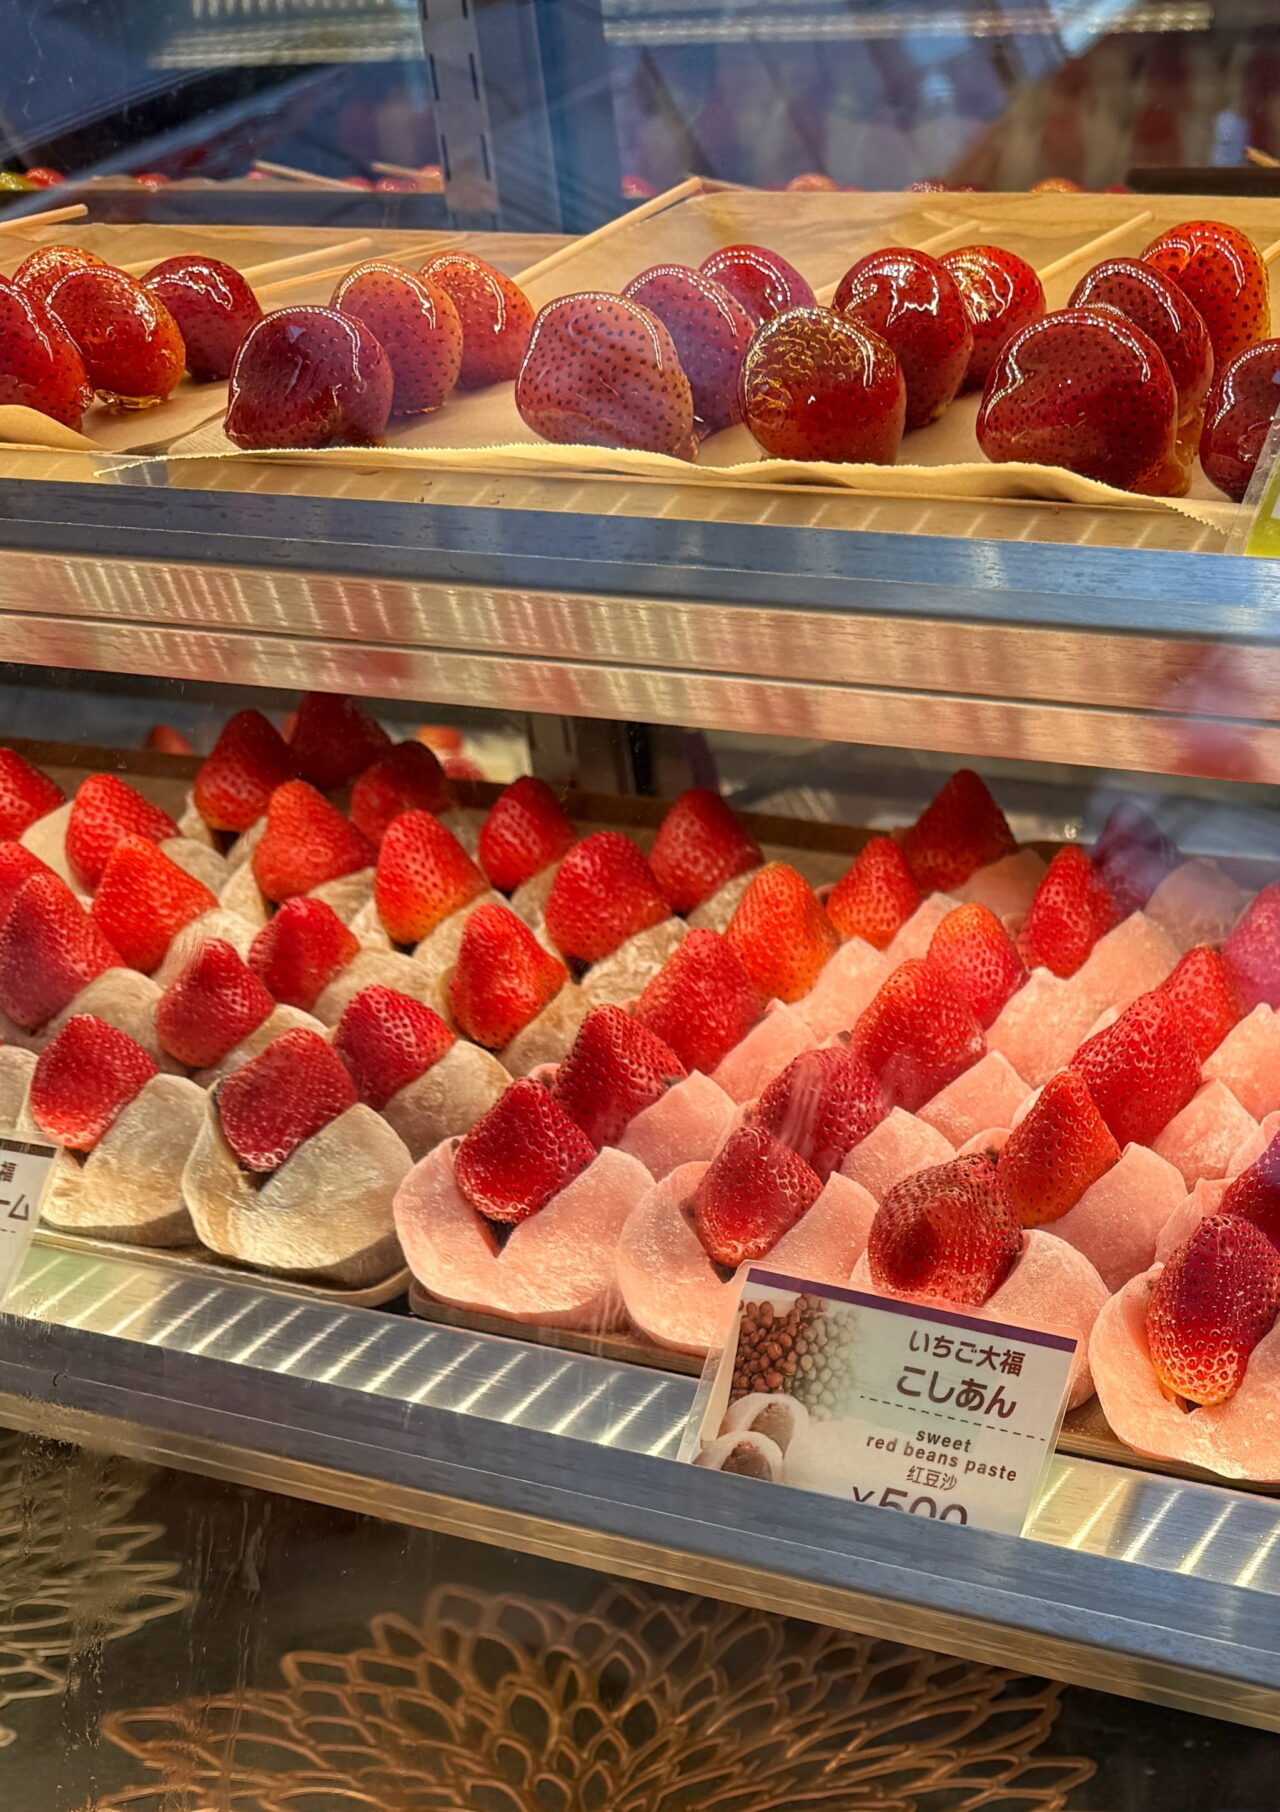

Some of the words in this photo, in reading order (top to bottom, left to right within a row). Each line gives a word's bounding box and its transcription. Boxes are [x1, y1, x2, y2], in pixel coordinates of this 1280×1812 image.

[908, 1330, 1027, 1378] いちご大福
[896, 1365, 1018, 1419] こしあん
[866, 1434, 898, 1453] red
[903, 1441, 958, 1468] beans
[963, 1459, 1018, 1482] paste
[915, 1429, 972, 1453] sweet
[906, 1464, 958, 1491] 红豆沙
